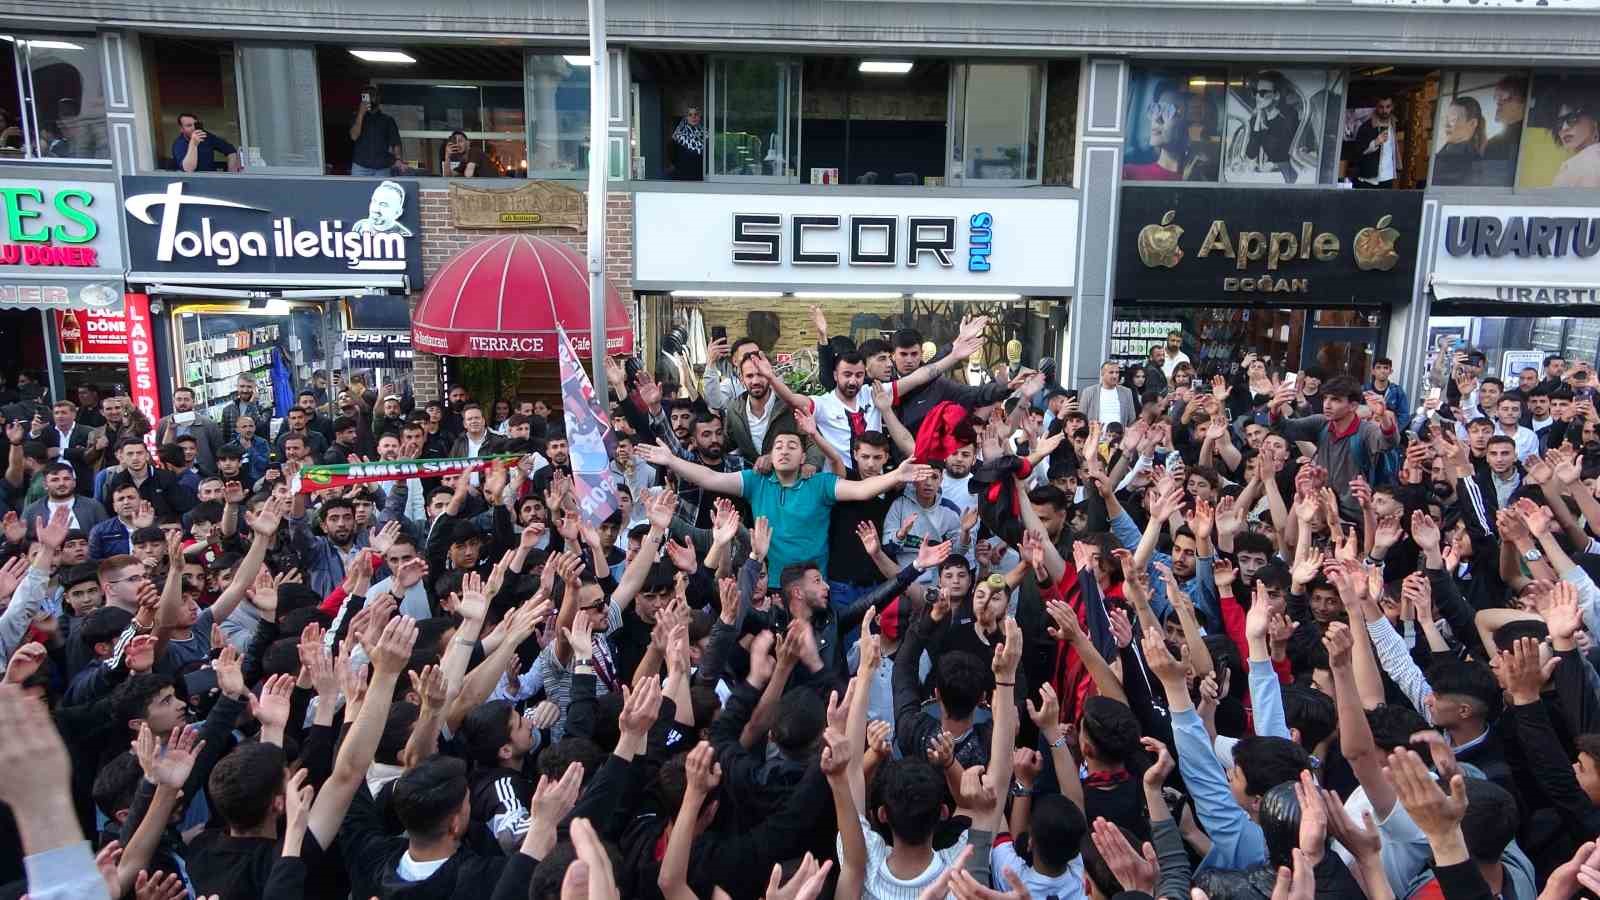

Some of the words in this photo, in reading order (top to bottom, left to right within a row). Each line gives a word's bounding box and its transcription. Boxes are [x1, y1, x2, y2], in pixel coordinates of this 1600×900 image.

[0, 187, 97, 243] ES
[125, 182, 271, 266] Tolga
[1445, 216, 1600, 258] URARTU
[732, 212, 957, 267] SCOR
[968, 211, 993, 272] PLUS
[1196, 219, 1341, 270] Apple
[1223, 274, 1308, 292] DOĞAN
[129, 305, 151, 390] LADES
[351, 349, 385, 360] iPhone
[469, 336, 544, 352] TERRACE
[570, 336, 590, 350] Cafe
